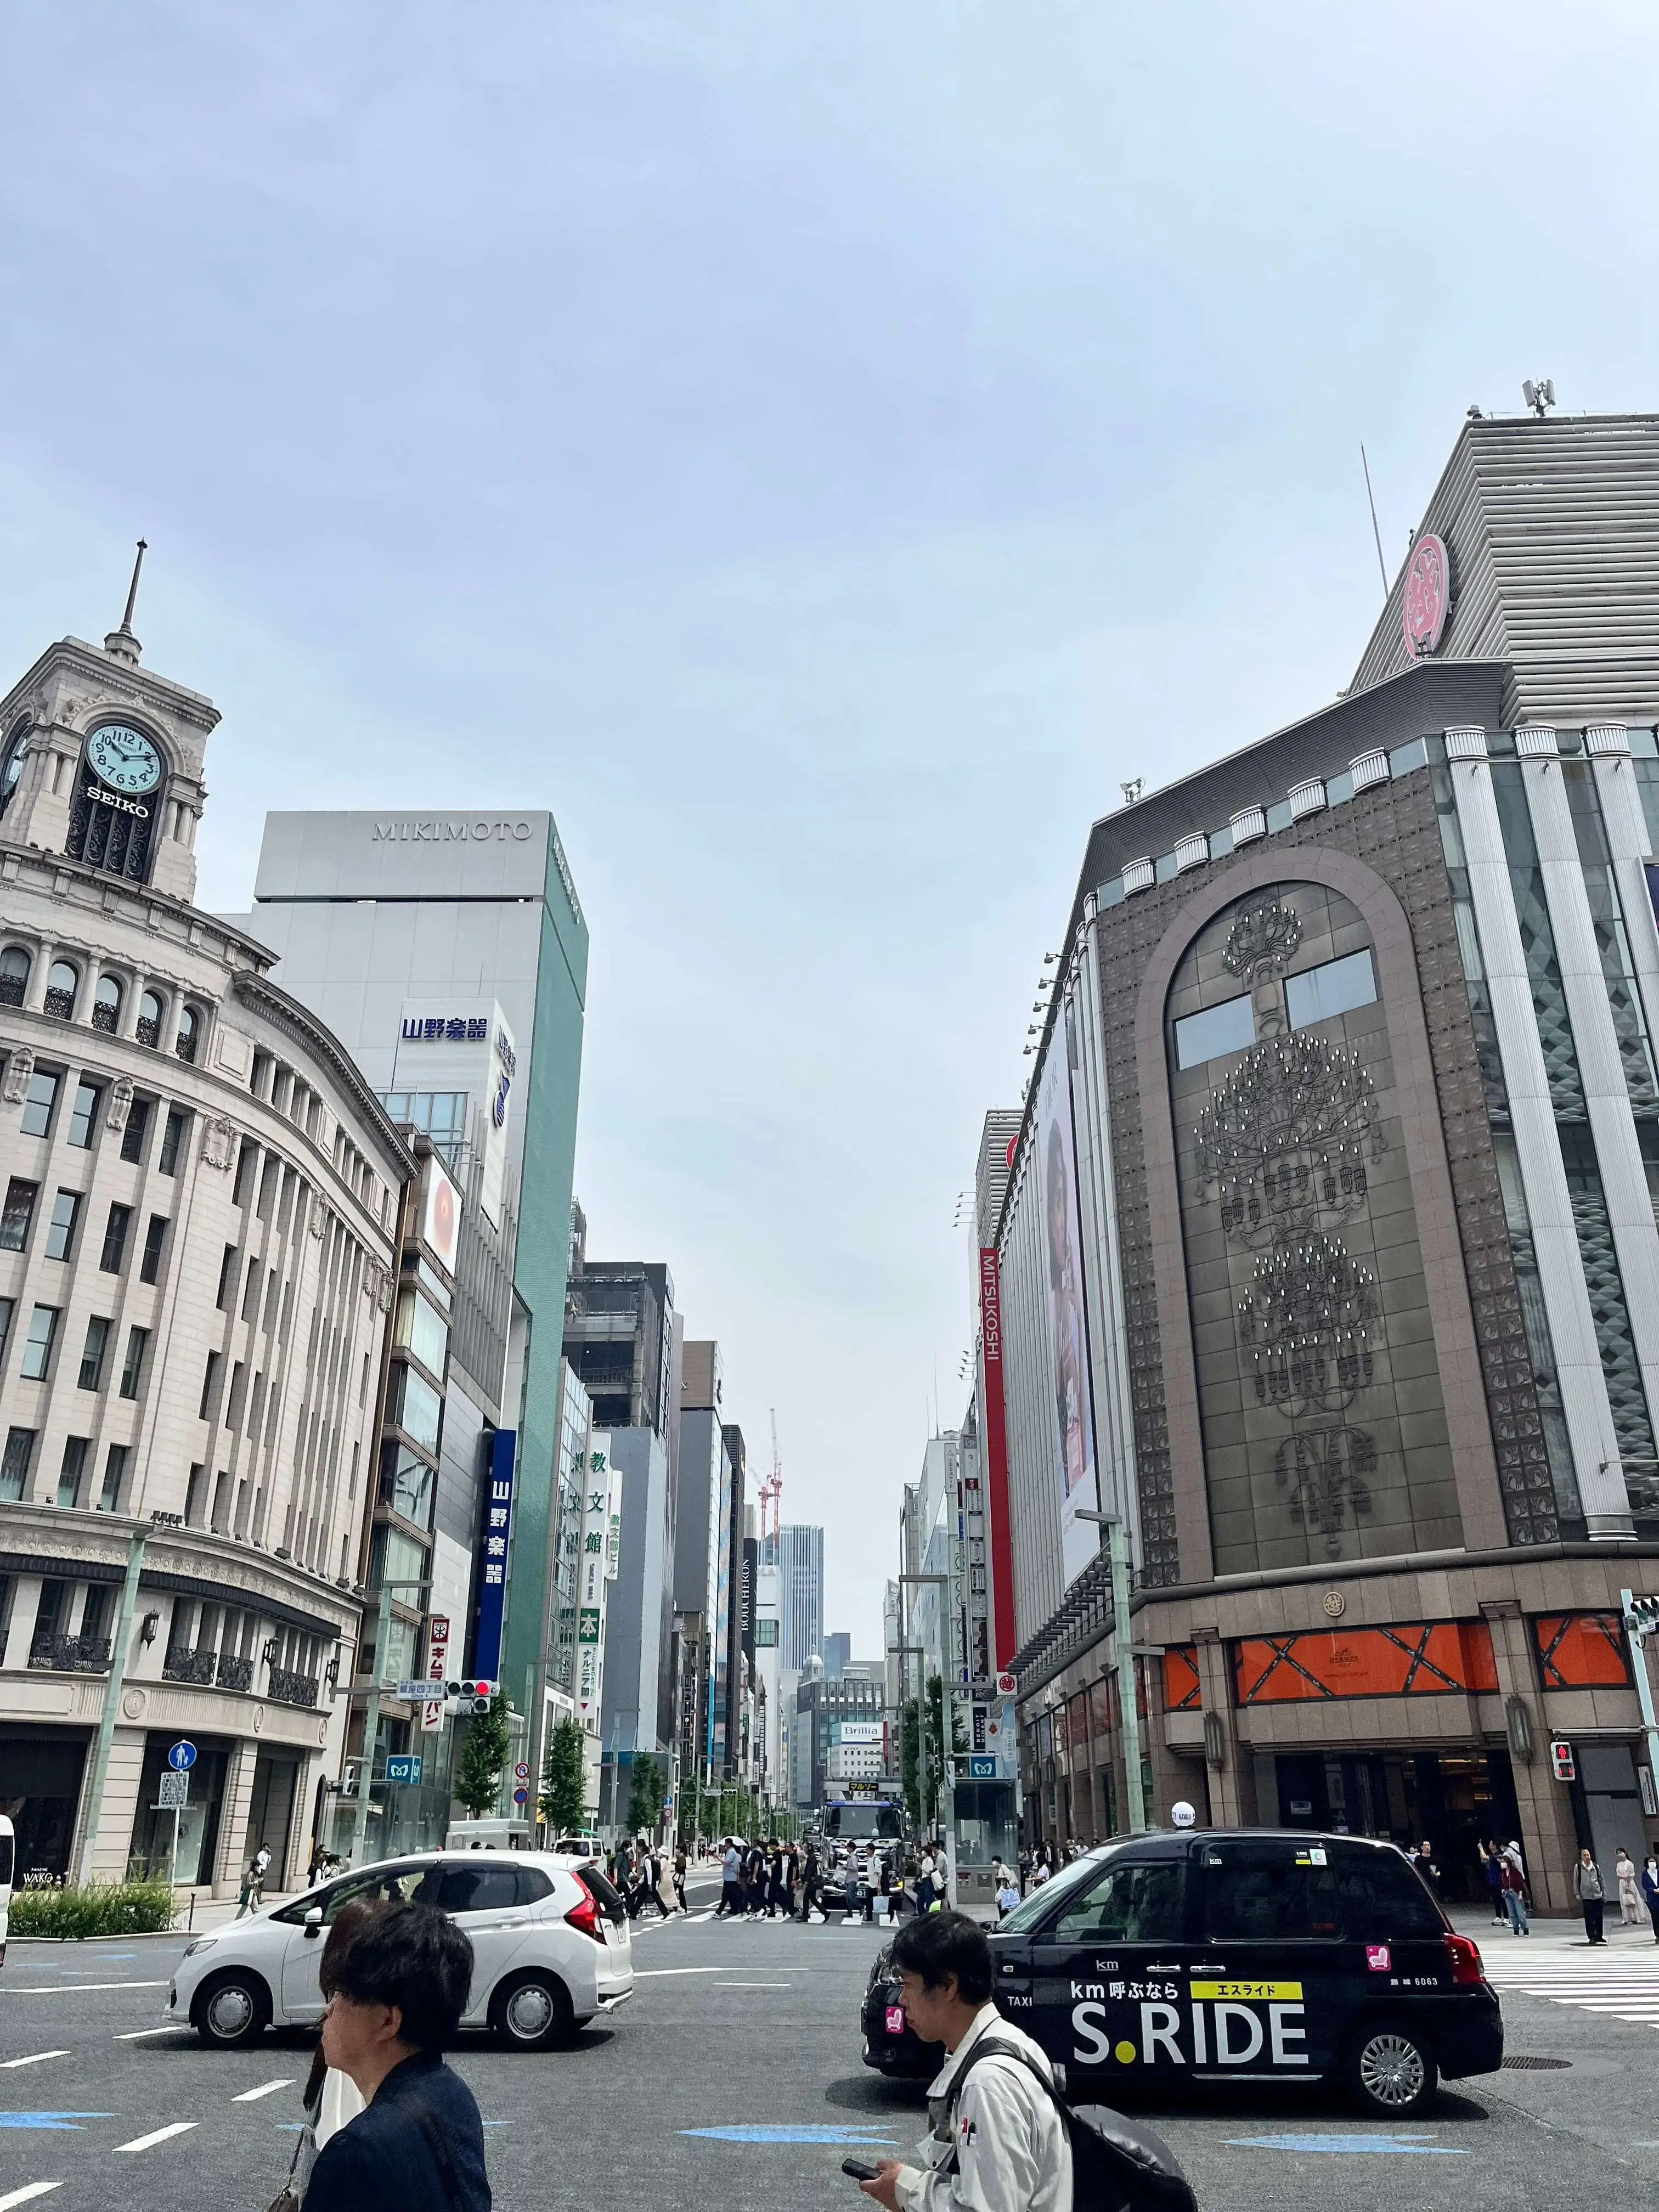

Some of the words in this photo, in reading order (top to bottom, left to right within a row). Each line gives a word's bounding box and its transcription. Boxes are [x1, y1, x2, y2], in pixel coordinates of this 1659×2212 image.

[87, 786, 149, 819] SEIKO
[373, 823, 533, 841] MIKIMOTO
[402, 1018, 488, 1039] 山野楽器
[983, 1255, 999, 1361] MITSUKOSHI
[584, 1451, 606, 1555] 教文館
[485, 1481, 510, 1584] 山野楽器
[609, 1514, 621, 1573] 教文館ビル
[741, 1559, 751, 1631] BOUCHERON
[580, 1614, 597, 1638] 本
[400, 1685, 442, 1694] 銀座四丁目
[23, 1872, 54, 1883] WAKO
[1096, 1960, 1119, 1971] km
[1070, 1980, 1105, 1999] km
[1109, 1982, 1178, 2000] 呼ぶなら
[1217, 1984, 1276, 1996] エスライド
[1007, 1996, 1032, 2007] TAXI
[1072, 2001, 1310, 2064] S.RIDE
